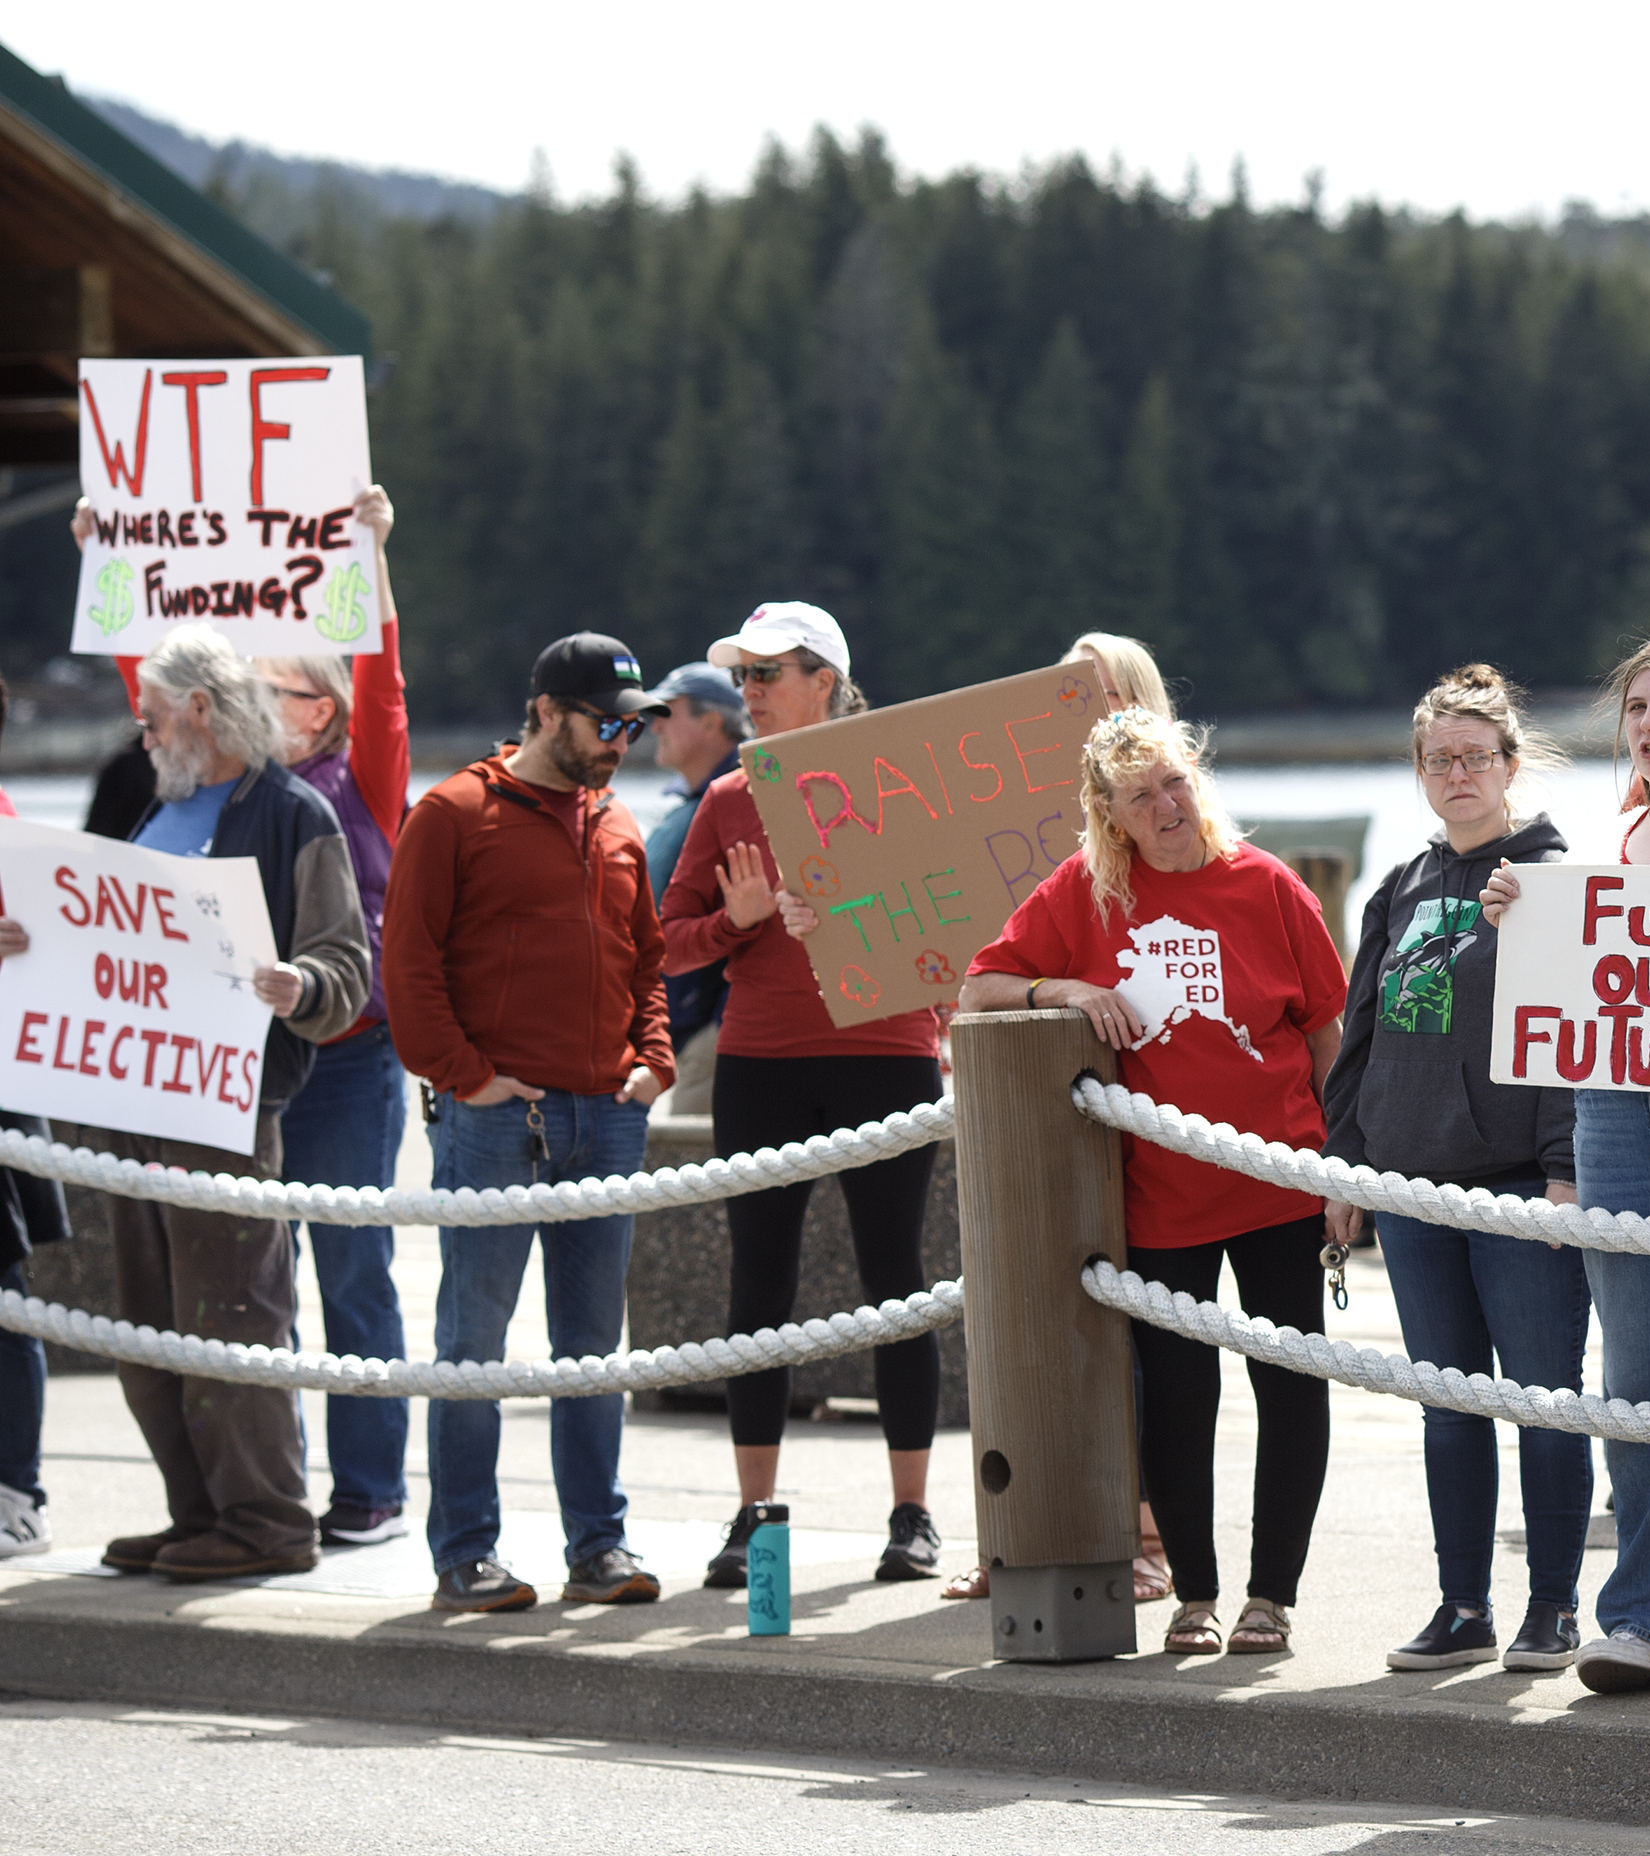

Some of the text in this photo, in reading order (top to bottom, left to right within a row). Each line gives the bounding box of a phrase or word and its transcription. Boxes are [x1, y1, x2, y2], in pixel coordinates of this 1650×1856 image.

[82, 367, 332, 507] WTF
[94, 507, 354, 550] WHERE'S THE
[144, 556, 324, 621] FUNDING?
[795, 712, 1075, 850] RAISE
[53, 865, 190, 943] SAVE
[829, 868, 971, 953] THE
[1435, 902, 1479, 922] HGGINS
[1147, 938, 1216, 957] #RED
[1165, 962, 1218, 979] FOR
[94, 951, 170, 1010] OUR
[1186, 985, 1220, 1003] ED
[14, 1010, 259, 1114] ELECTIVES
